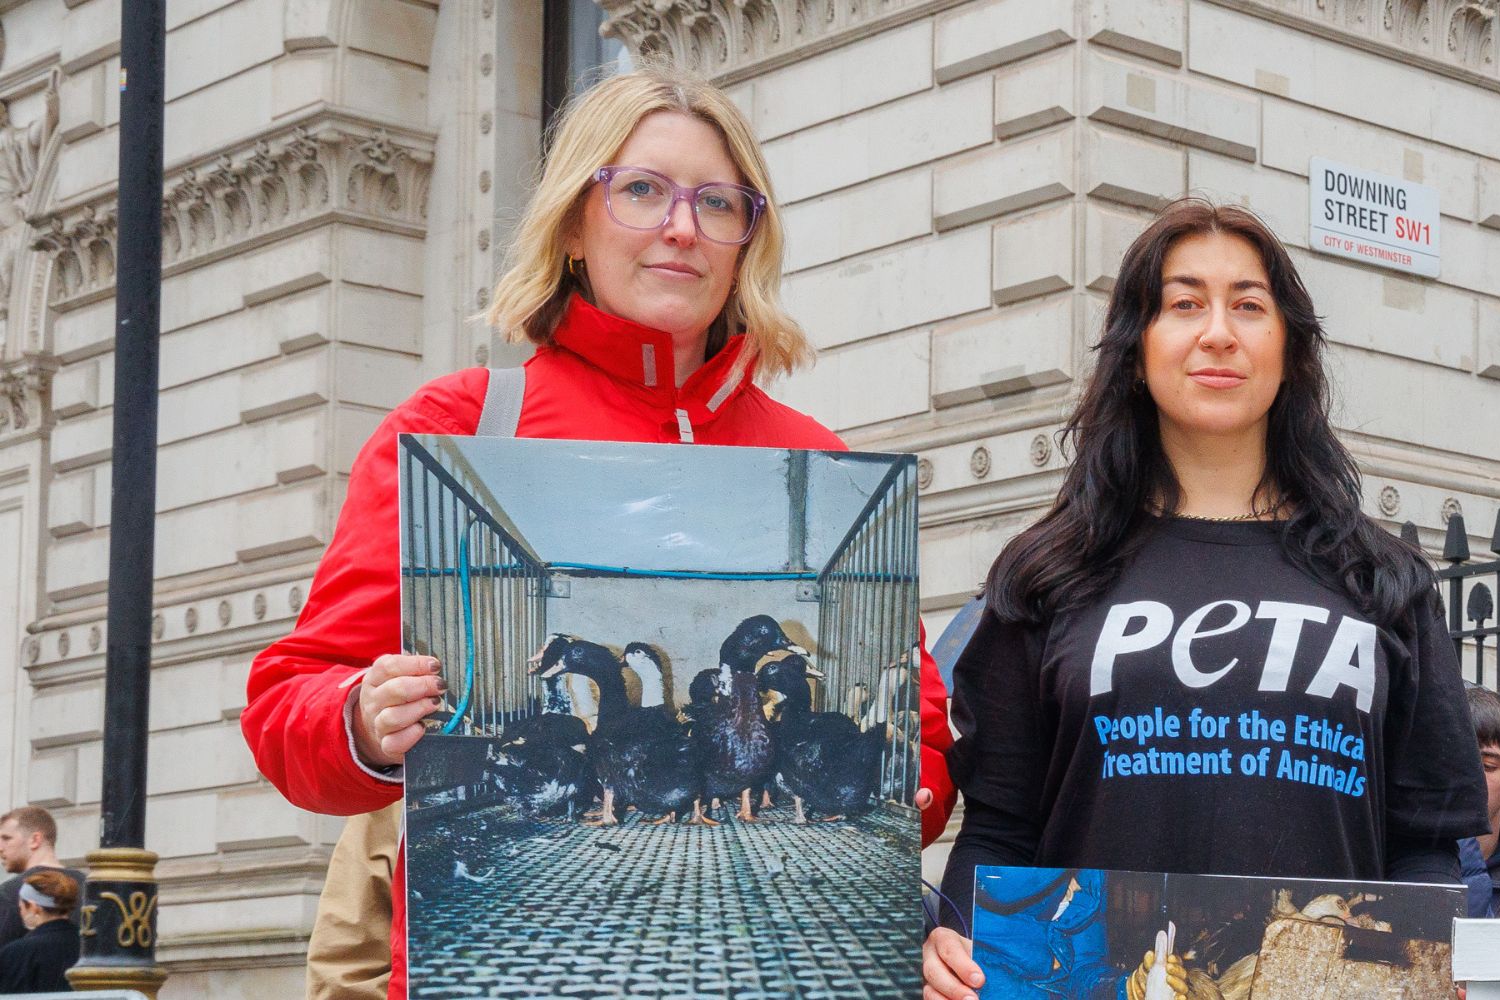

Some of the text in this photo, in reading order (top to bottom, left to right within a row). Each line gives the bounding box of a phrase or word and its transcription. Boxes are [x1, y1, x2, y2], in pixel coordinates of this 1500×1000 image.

[1325, 169, 1406, 211] DOWNING
[1325, 198, 1430, 245] STREET SW1
[1324, 235, 1412, 266] CITY OF WESTMINSTER
[1093, 707, 1366, 761] People for the Ethica
[1240, 747, 1270, 776] of
[1276, 750, 1367, 797] Animals
